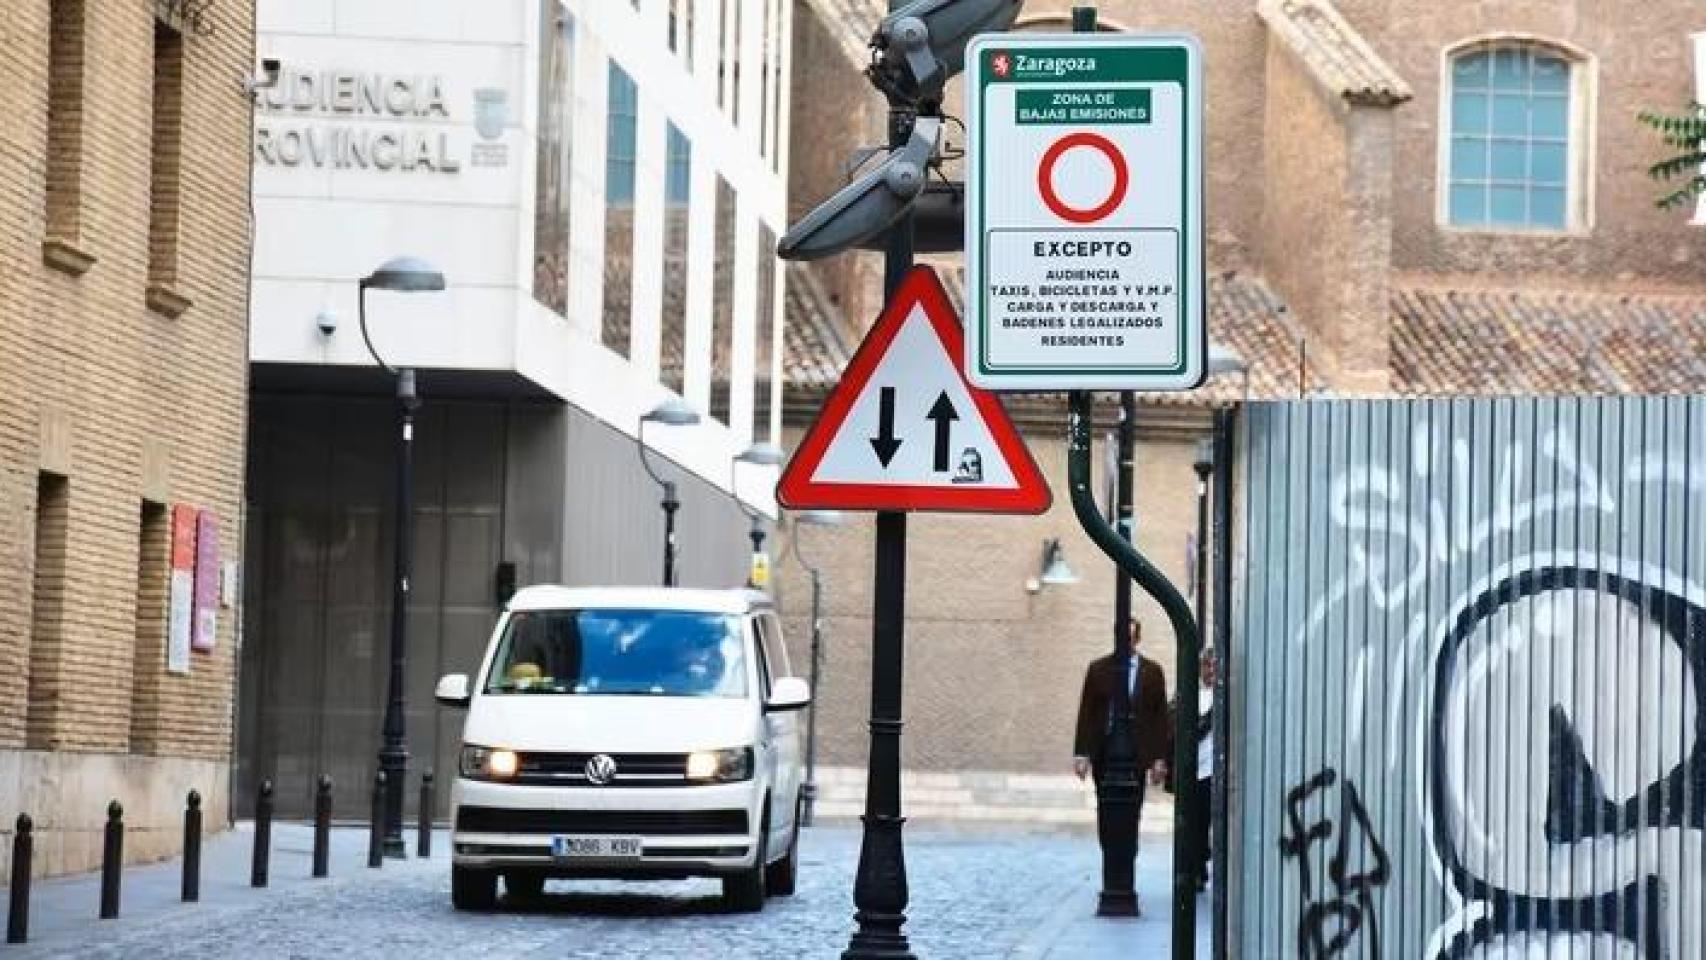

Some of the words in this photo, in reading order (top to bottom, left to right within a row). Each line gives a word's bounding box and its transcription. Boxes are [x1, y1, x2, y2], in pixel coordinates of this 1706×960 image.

[1015, 55, 1096, 76] Zaragoza
[1053, 93, 1093, 105] ZONA
[1095, 93, 1116, 105] DE
[1019, 108, 1067, 120] BAJAS
[1070, 108, 1147, 120] EMISIONES
[254, 127, 461, 174] ROVINCIAL
[1033, 241, 1132, 257] EXCEPTO
[1046, 270, 1120, 281] AUDIENCIA
[991, 285, 1036, 297] TAXIS,
[1038, 285, 1118, 296] BICICLETAS
[1123, 285, 1132, 296] Y
[1007, 302, 1055, 313] CARGA
[1059, 302, 1068, 313] Y
[1070, 302, 1147, 313] DESCARGA
[1150, 302, 1159, 313] Y
[1002, 317, 1066, 329] BADENES
[1070, 317, 1164, 329] LEGALIZADOS
[1041, 336, 1125, 347] RESIDENTES
